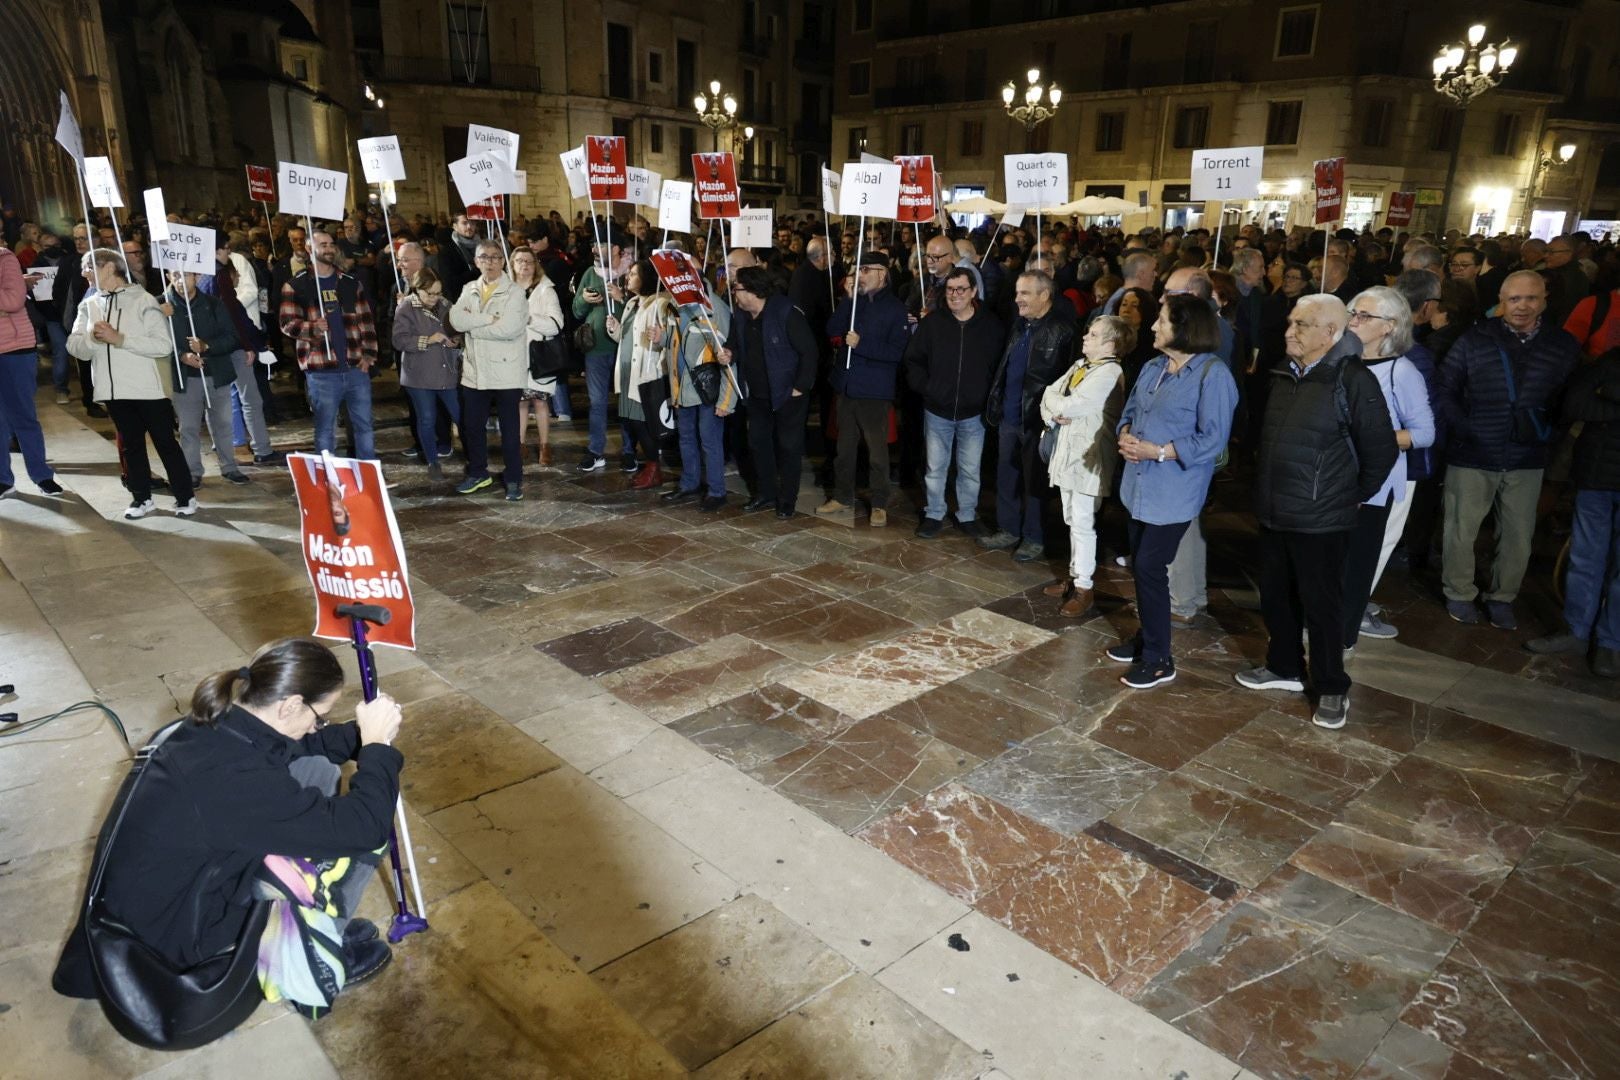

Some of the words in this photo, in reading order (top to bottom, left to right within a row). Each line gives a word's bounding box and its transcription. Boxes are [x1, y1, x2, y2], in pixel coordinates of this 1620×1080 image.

[474, 130, 513, 148] València
[469, 160, 493, 175] Silla
[590, 163, 616, 173] Mazón
[1016, 161, 1044, 171] Quart
[1046, 160, 1057, 169] de
[1202, 156, 1251, 169] Torrent
[288, 169, 337, 192] Bunyol
[484, 177, 492, 188] 1
[590, 174, 625, 185] dimissió
[629, 172, 650, 185] Utiel
[854, 171, 882, 185] Albal
[1017, 179, 1047, 189] Poblet
[1051, 175, 1059, 188] 7
[1216, 177, 1232, 189] 11
[634, 187, 641, 197] 6
[699, 179, 726, 192] Mazón
[899, 183, 923, 195] Mazón
[701, 190, 736, 203] dimissió
[860, 192, 868, 205] 3
[900, 194, 932, 206] dimissió
[169, 231, 183, 243] ot
[186, 233, 202, 246] de
[162, 247, 188, 262] Xera
[194, 252, 202, 264] 1
[309, 533, 374, 567] Mazón
[317, 566, 404, 600] dimissió
